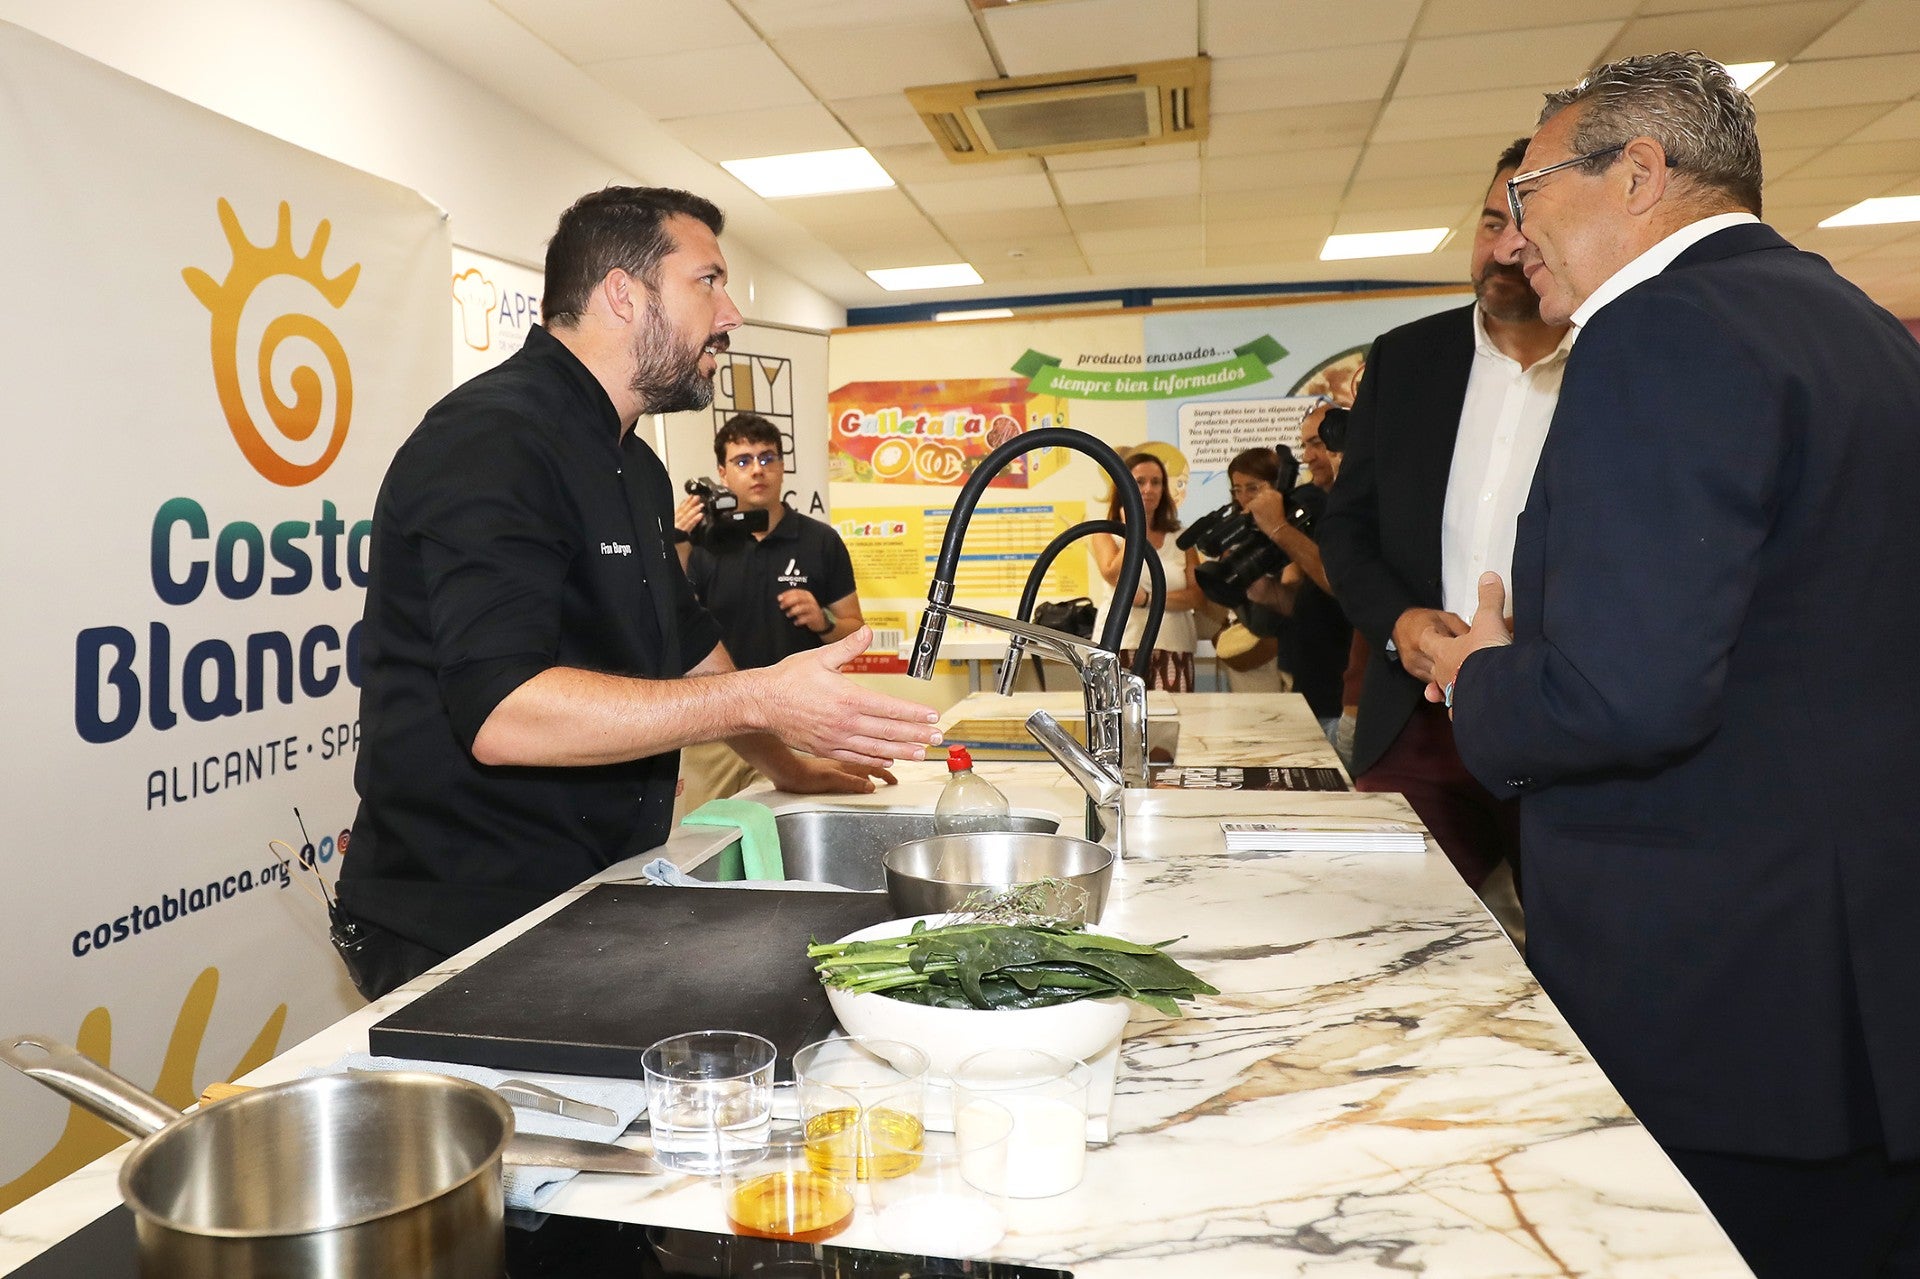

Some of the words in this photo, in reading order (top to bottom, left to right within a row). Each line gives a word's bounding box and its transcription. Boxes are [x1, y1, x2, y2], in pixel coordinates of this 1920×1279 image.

[1051, 375, 1111, 396] siempre
[1115, 377, 1149, 393] bien
[1153, 366, 1246, 395] informados
[1077, 352, 1142, 366] productos
[147, 736, 298, 811] ALICANTE
[72, 859, 291, 957] costablanca.org
